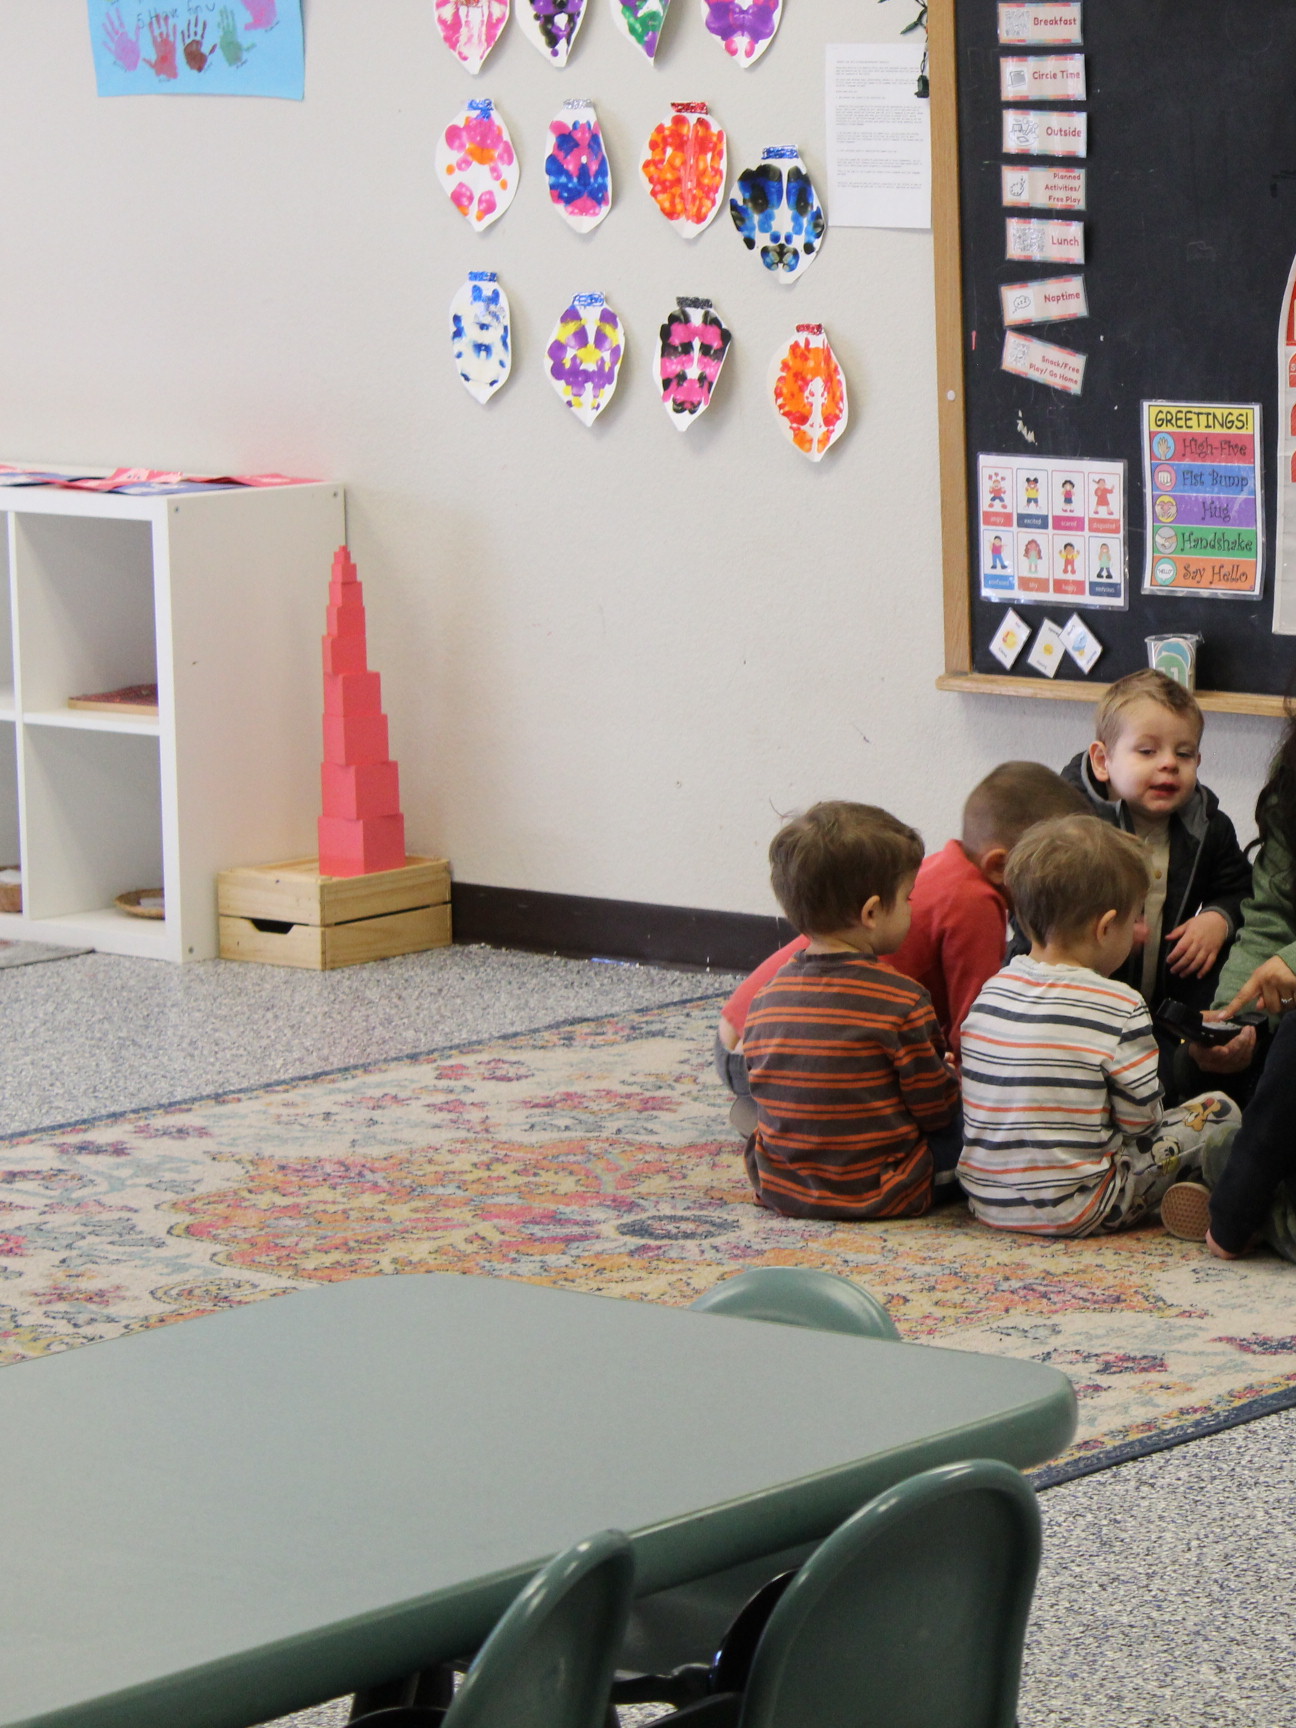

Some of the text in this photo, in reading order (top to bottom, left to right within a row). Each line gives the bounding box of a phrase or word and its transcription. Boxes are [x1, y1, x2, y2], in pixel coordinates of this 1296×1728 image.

[1033, 17, 1077, 26] Breakfast
[1032, 70, 1080, 80] Circle Time
[1046, 126, 1082, 137] Outside
[1053, 172, 1081, 180] Planned
[1044, 184, 1081, 192] Activities/
[1048, 195, 1081, 205] Free Play
[1051, 236, 1079, 246] Lunch
[1044, 291, 1081, 304] Naptime
[1041, 355, 1080, 374] Snack/Free
[1029, 362, 1078, 385] Play/ Go Home
[1154, 410, 1249, 430] GREETINGS!
[1181, 436, 1247, 459] High-Five
[1182, 468, 1249, 491] Fist Bump
[1201, 500, 1232, 523] Hug
[1180, 531, 1253, 552] Handshake
[1182, 563, 1248, 585] Say Hello
